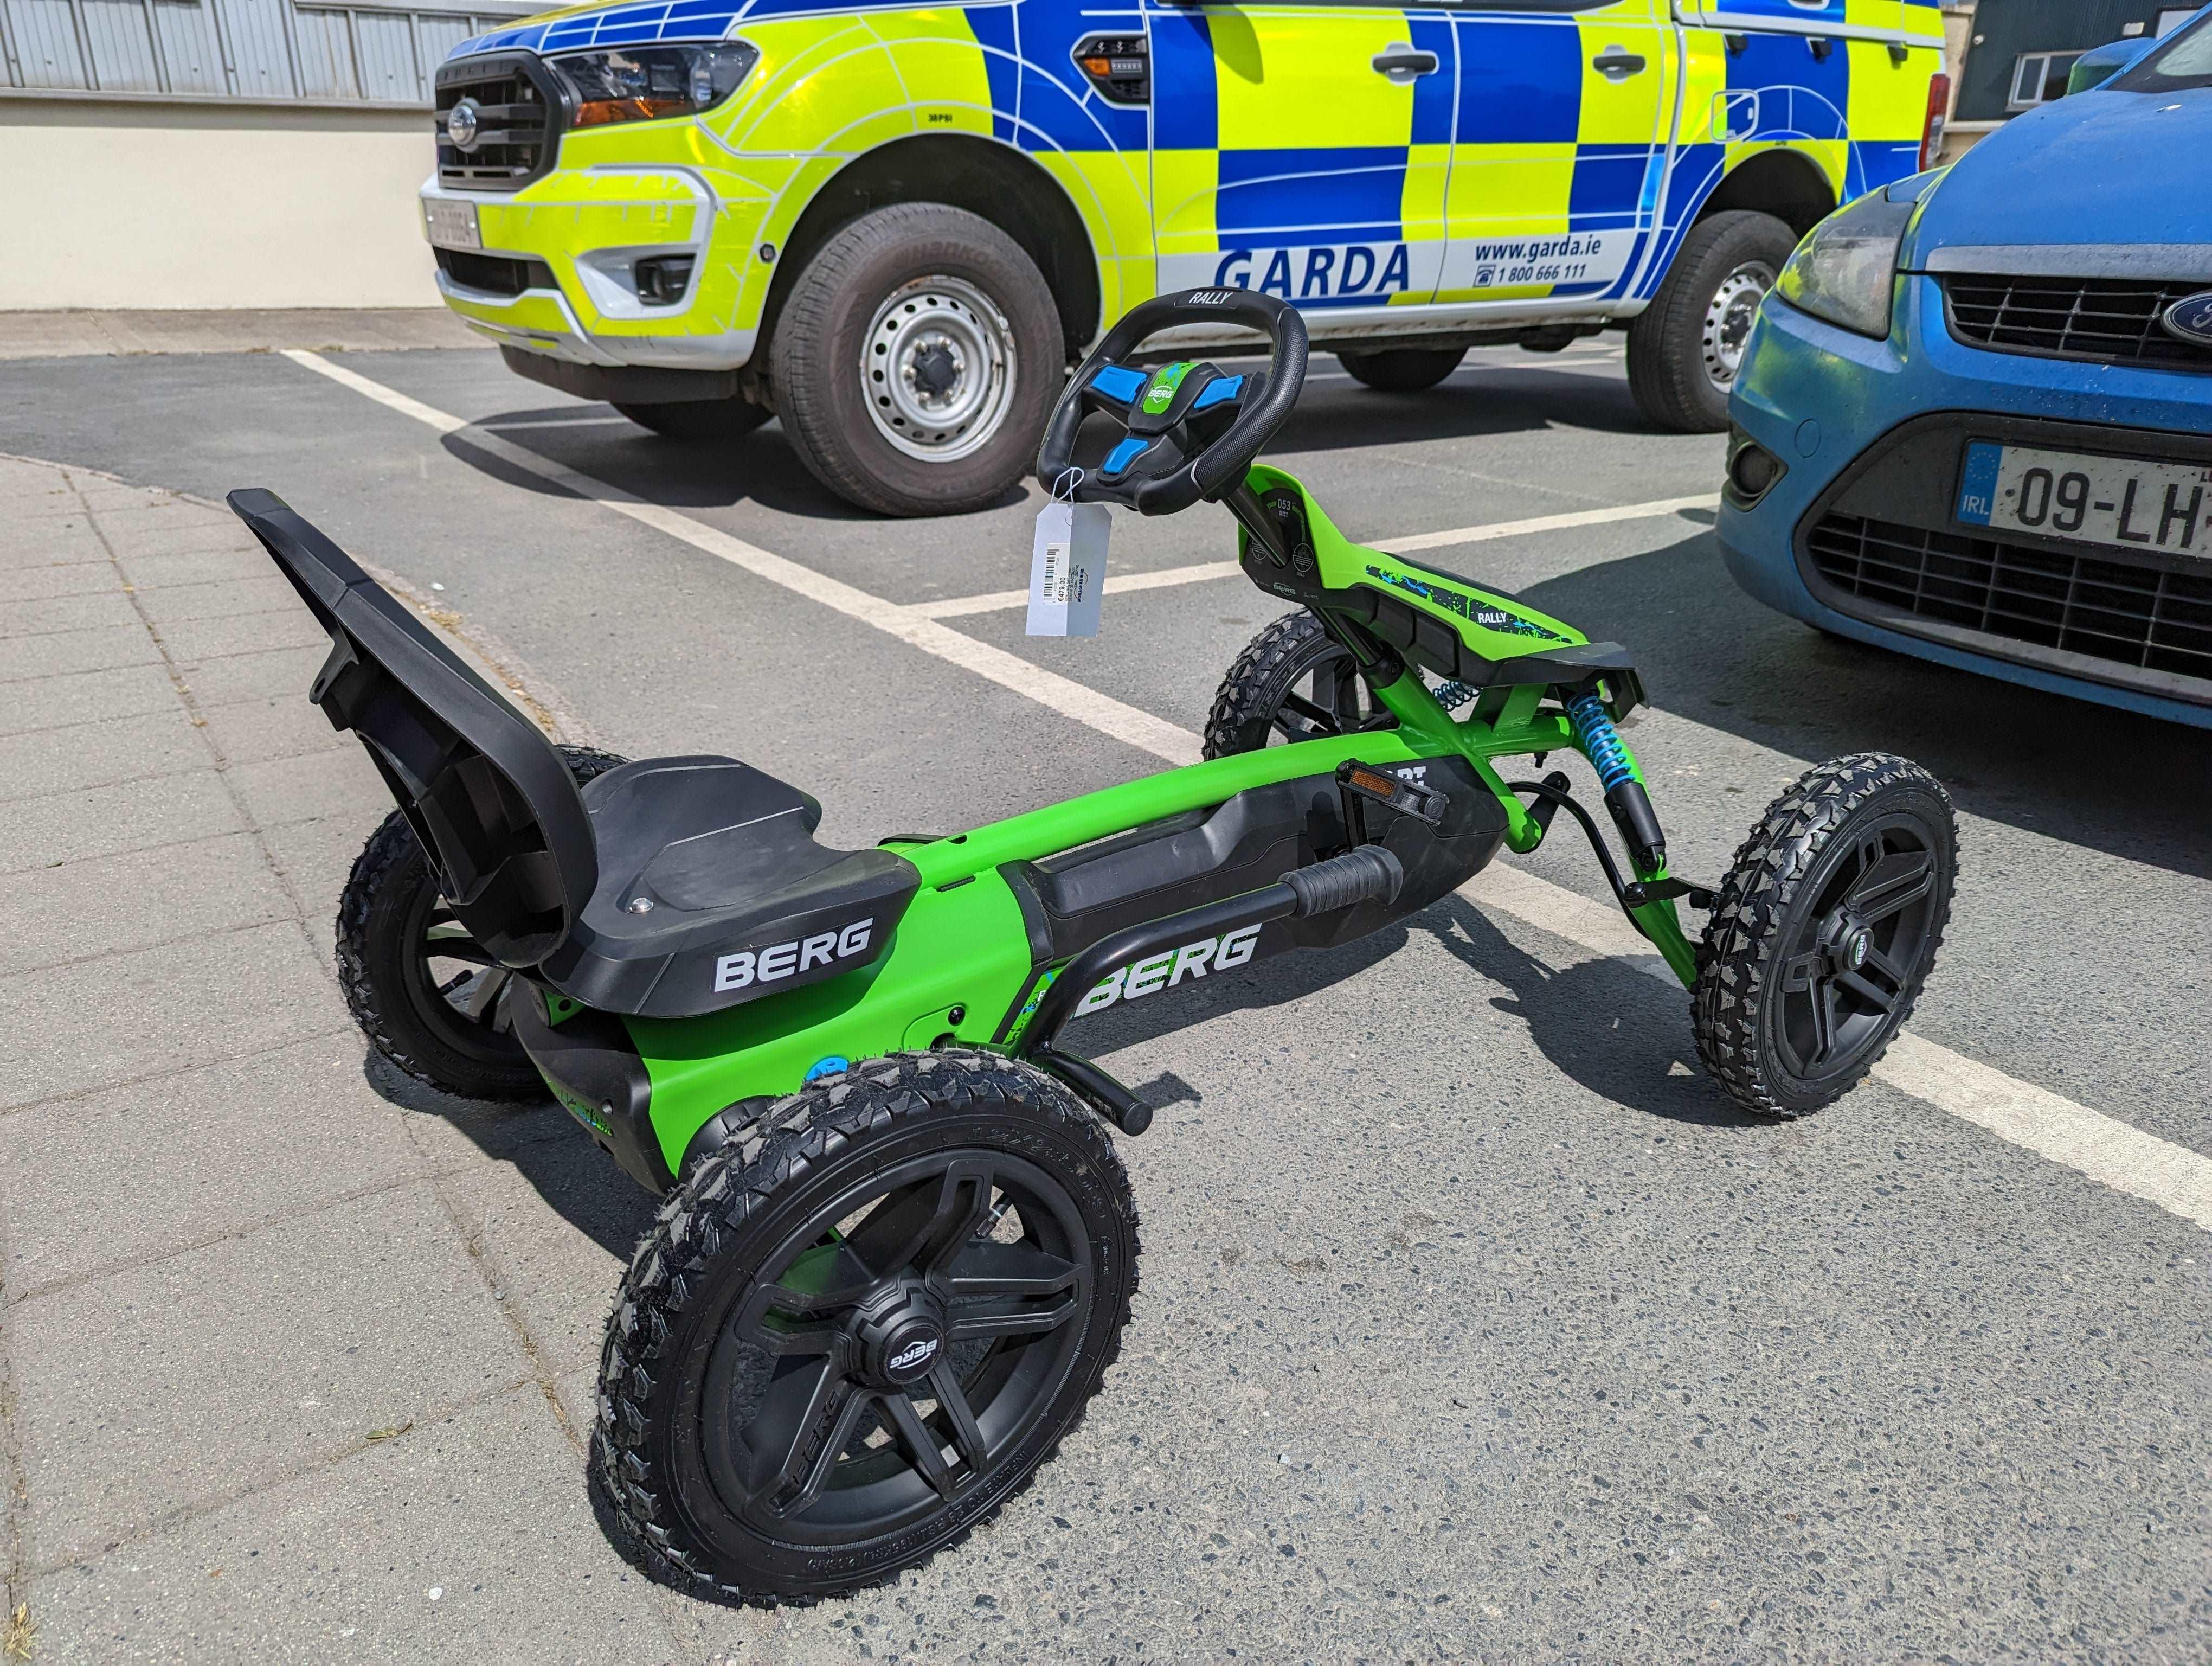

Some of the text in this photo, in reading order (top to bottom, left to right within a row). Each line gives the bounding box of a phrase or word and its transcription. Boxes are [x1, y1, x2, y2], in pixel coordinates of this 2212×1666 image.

[1475, 235, 1601, 263] www.garda.ie
[1214, 244, 1409, 298] GARDA
[1499, 263, 1587, 283] 1 800 666 111
[1189, 291, 1234, 304] RALLY
[1147, 389, 1175, 399] BERG
[1277, 498, 1291, 511] 053
[1962, 495, 1990, 516] IRL
[1058, 577, 1066, 601] €479.00
[1274, 584, 1296, 595] BERG
[1477, 611, 1507, 624] RALLY
[714, 917, 874, 991] BERG
[1075, 923, 1262, 1017] BERG
[889, 1338, 938, 1369] BERG
[791, 1391, 838, 1485] BERG
[986, 1450, 1029, 1495] INFLATE
[967, 1491, 985, 1509] TO
